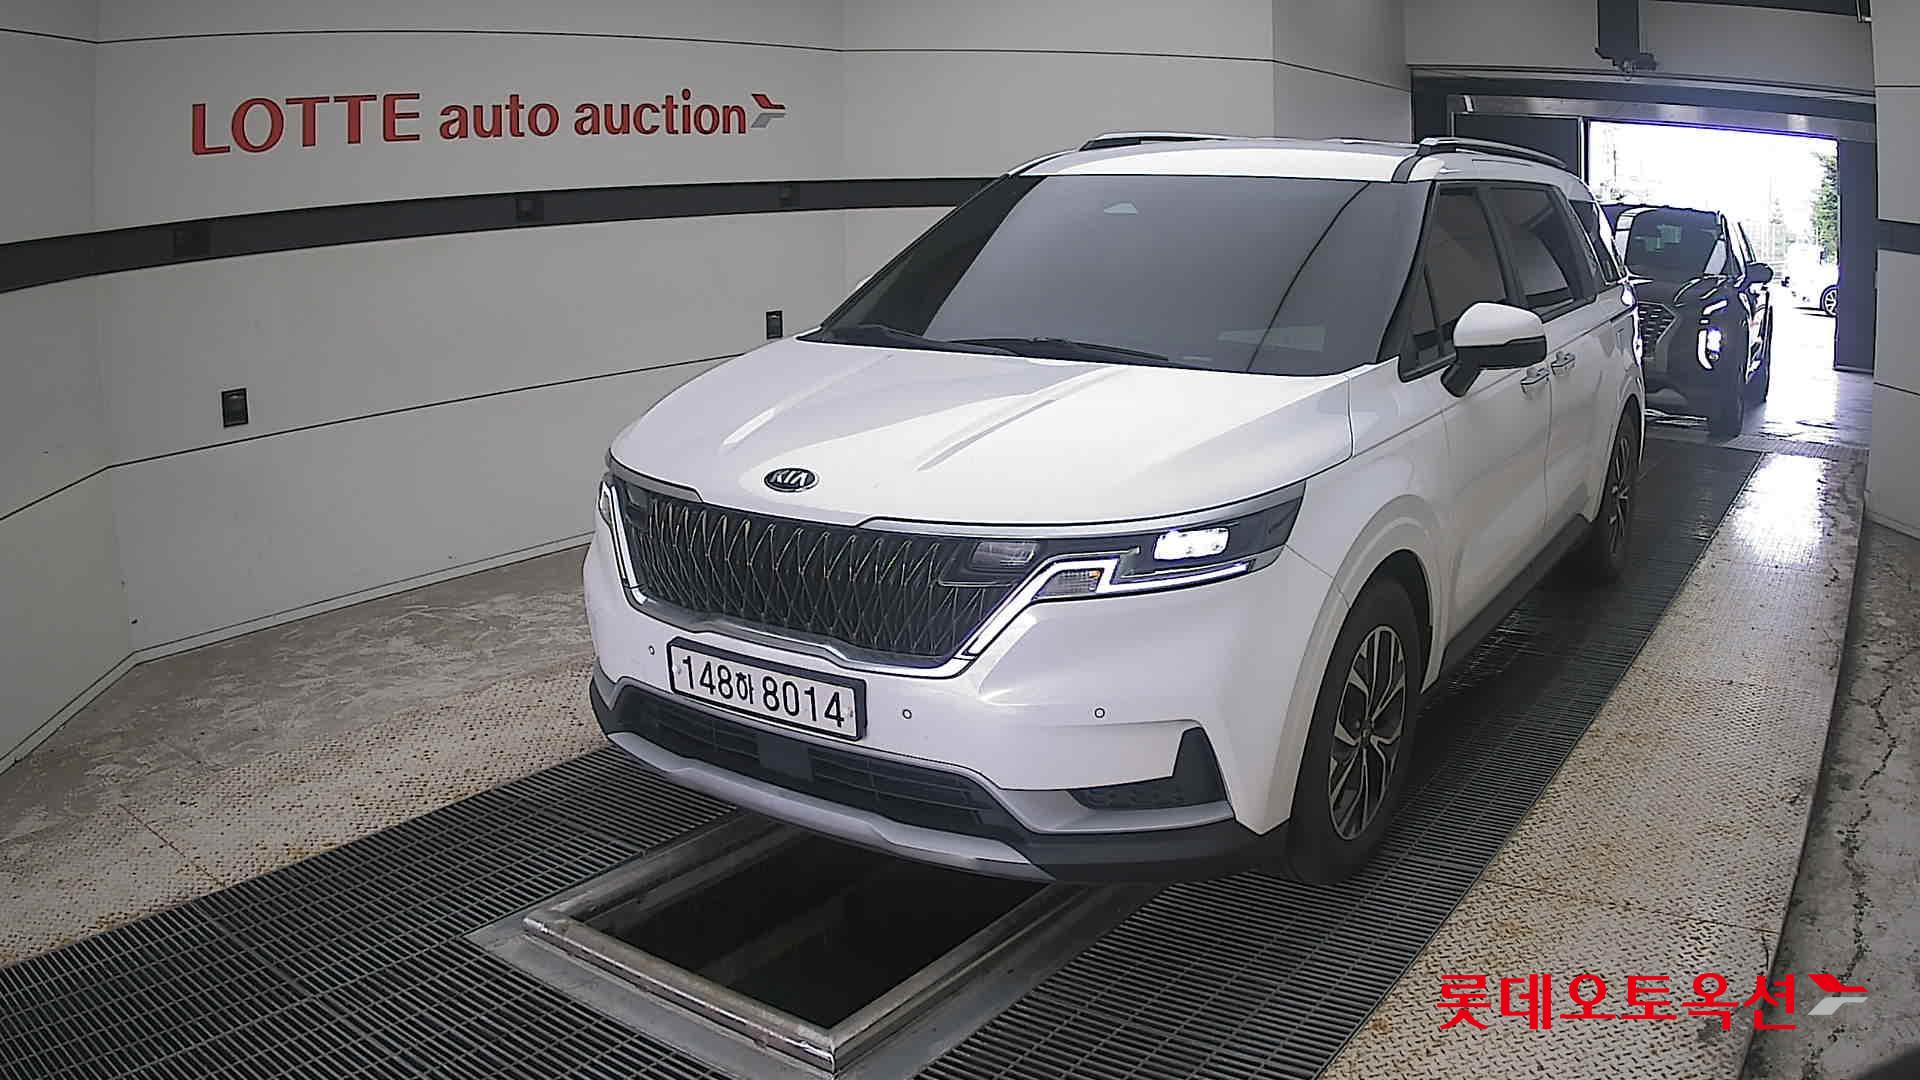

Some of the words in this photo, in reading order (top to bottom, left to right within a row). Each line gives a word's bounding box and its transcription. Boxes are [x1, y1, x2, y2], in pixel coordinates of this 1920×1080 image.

[191, 93, 420, 155] LOTTE
[439, 94, 560, 139] auto
[574, 89, 748, 135] auction
[767, 469, 811, 488] KIA
[761, 676, 845, 727] 8014
